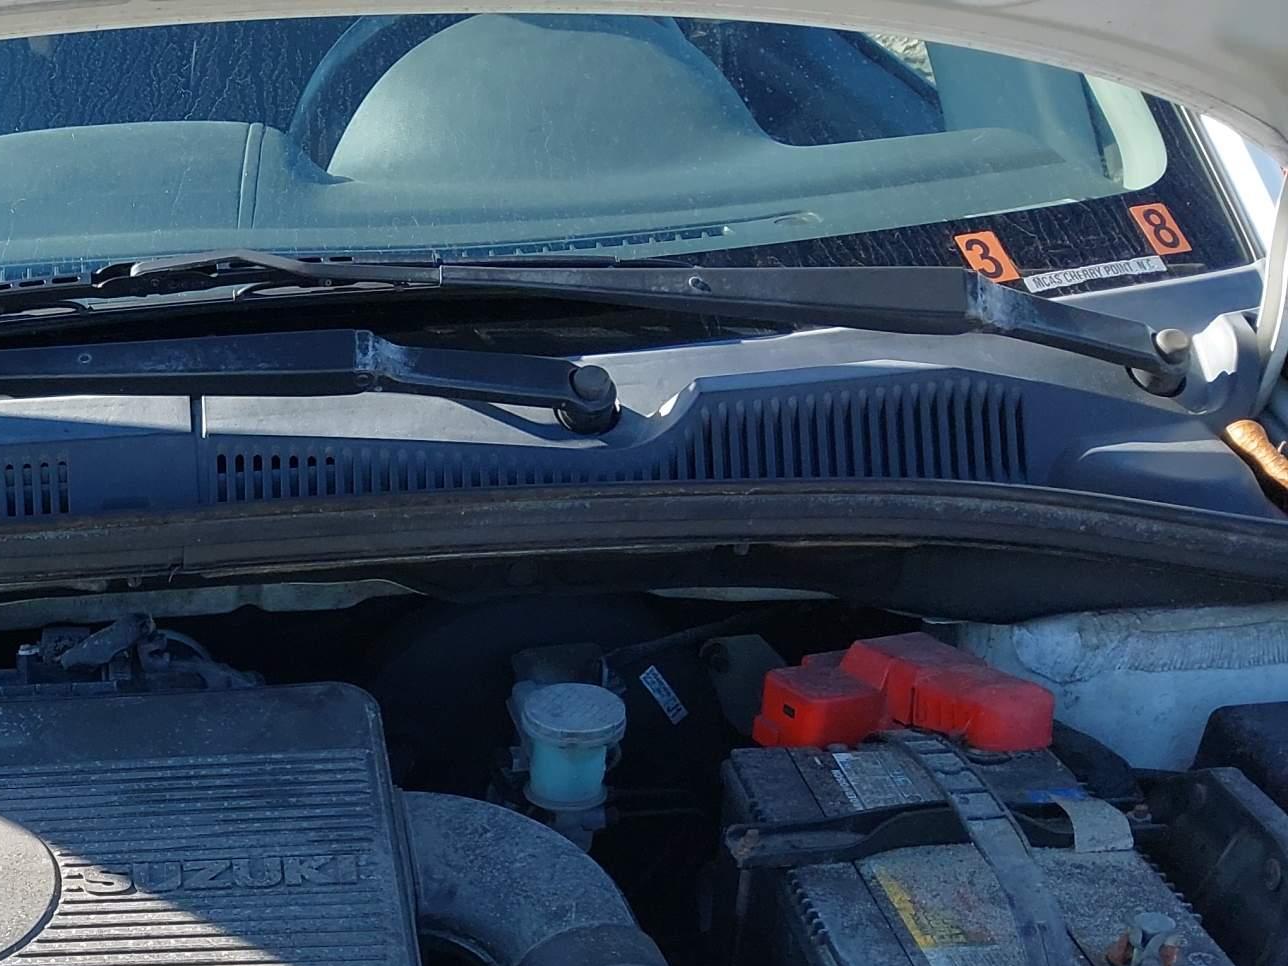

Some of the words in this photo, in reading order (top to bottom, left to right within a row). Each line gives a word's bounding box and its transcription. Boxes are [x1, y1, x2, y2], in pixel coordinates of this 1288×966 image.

[1143, 207, 1180, 249] 8
[964, 238, 1003, 279] 3
[1033, 274, 1063, 289] MCAS
[1063, 267, 1102, 283] CHERRY
[83, 854, 360, 896] SUZUKI
